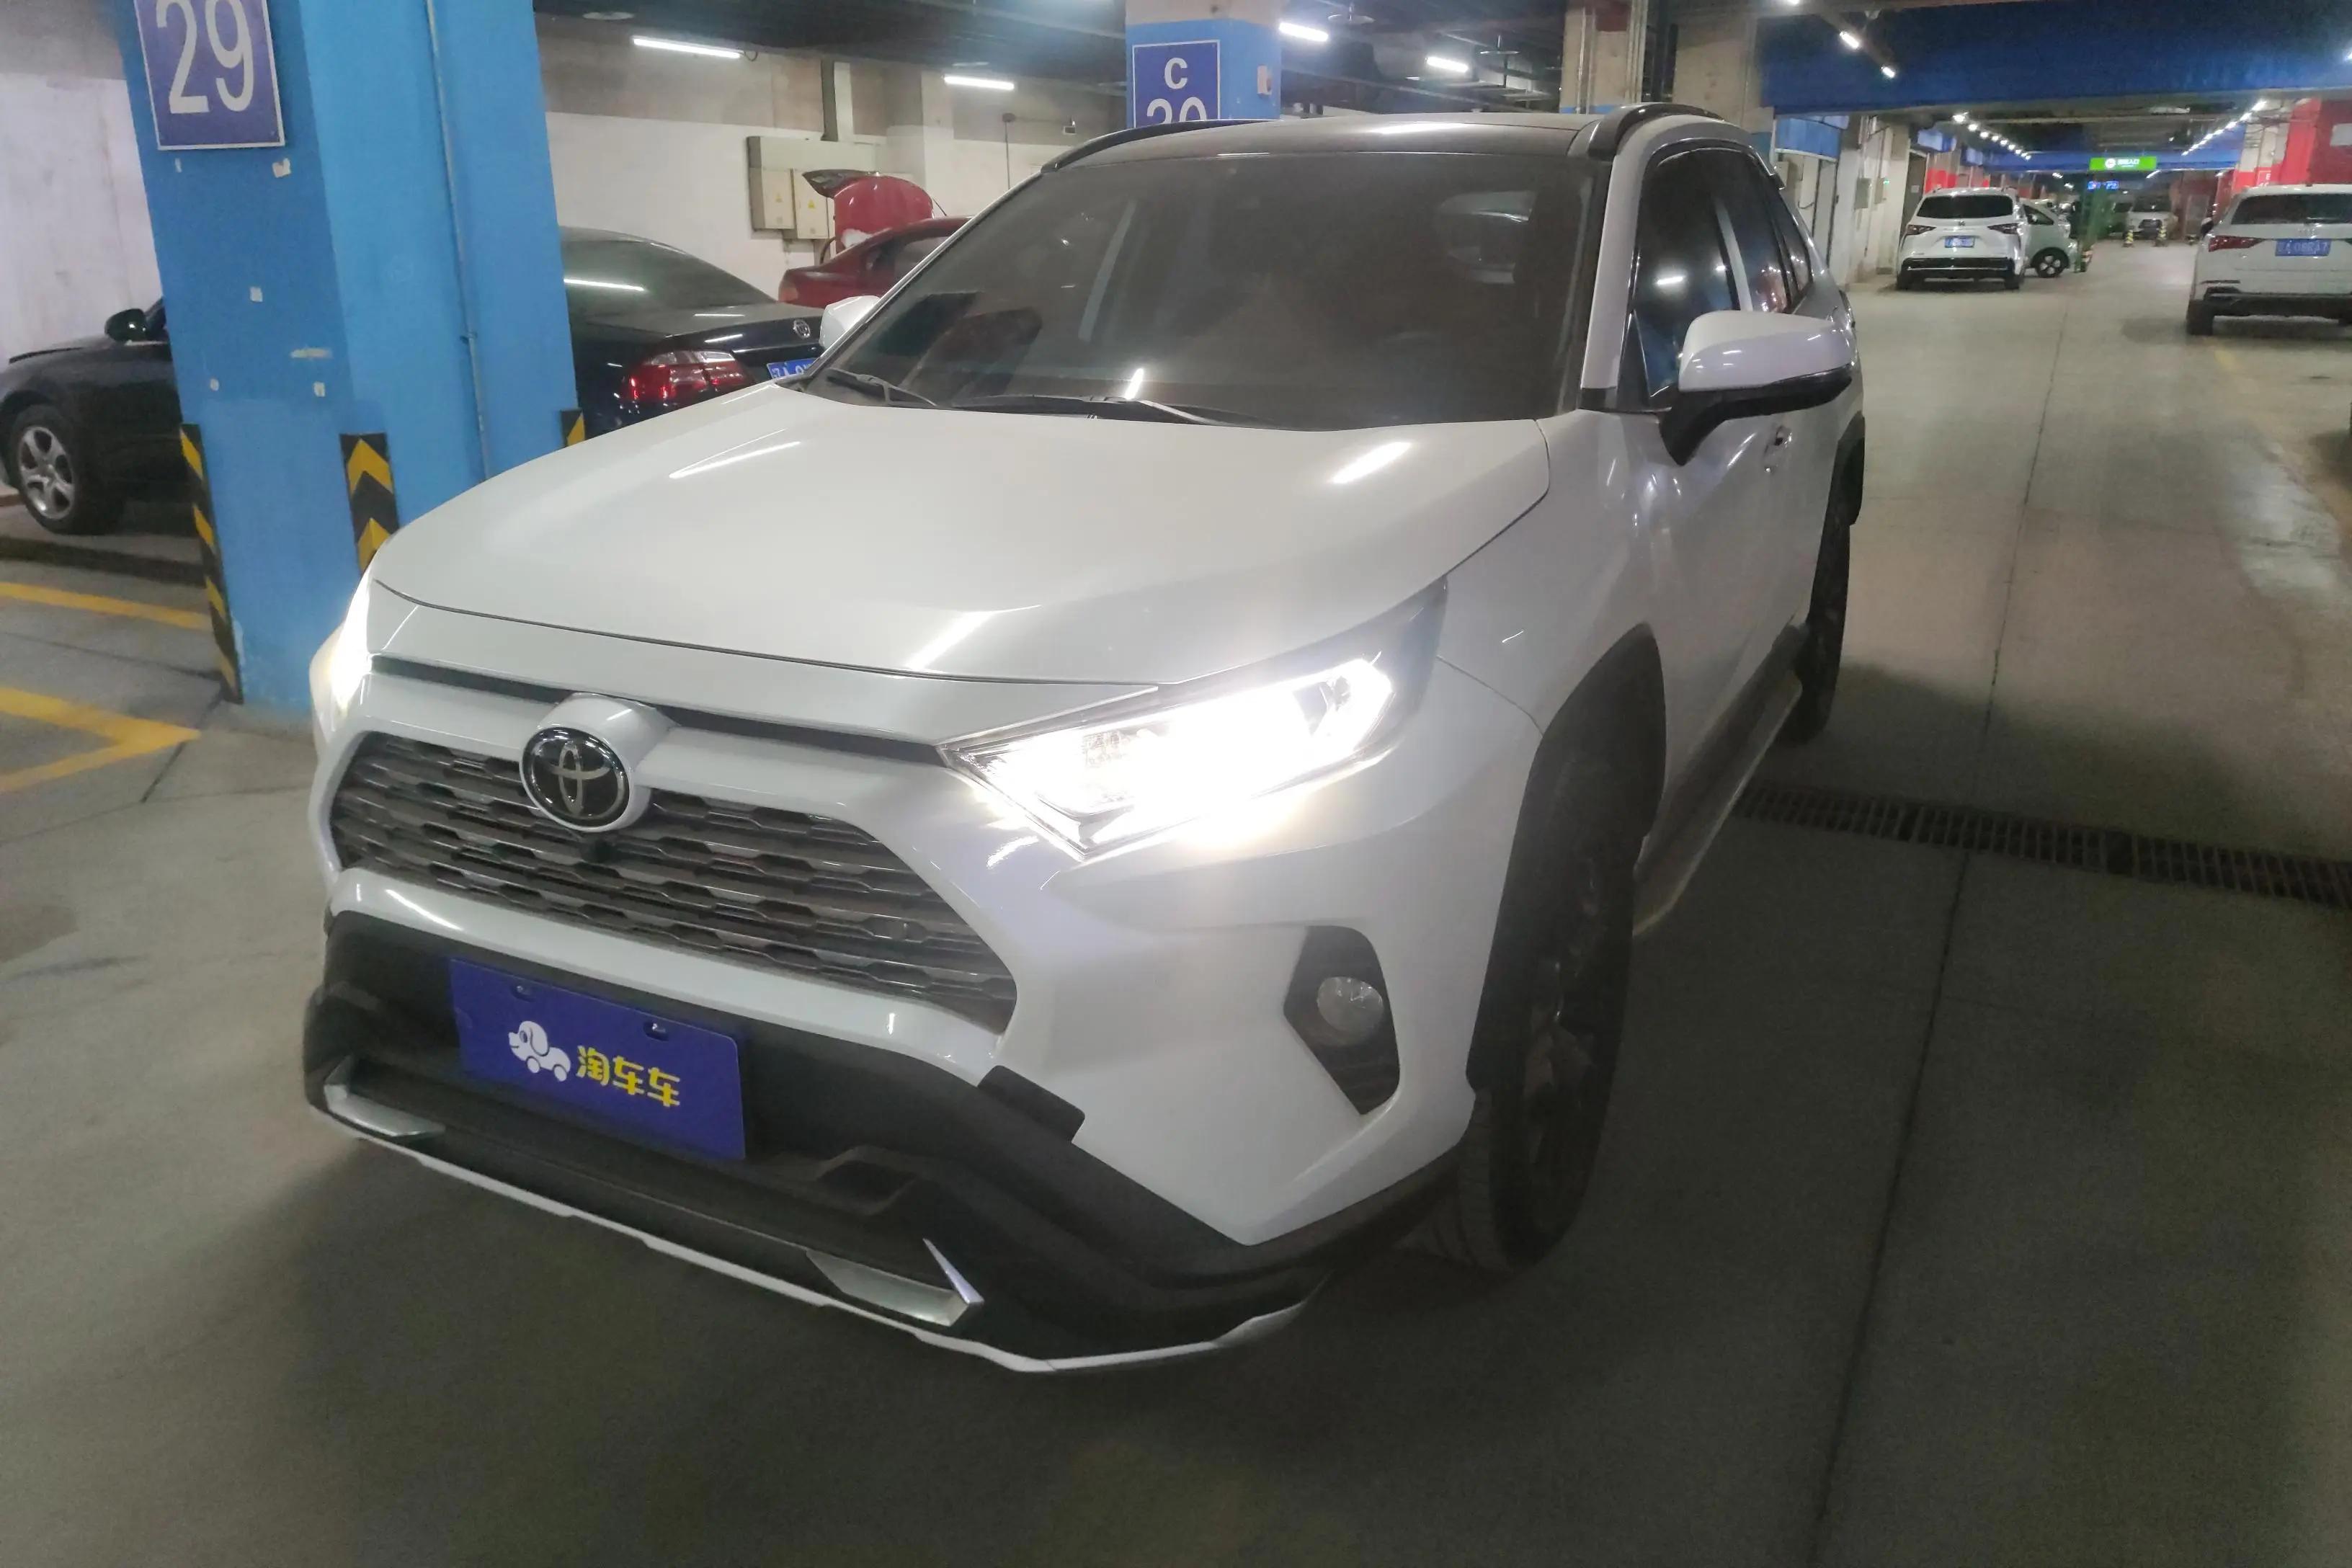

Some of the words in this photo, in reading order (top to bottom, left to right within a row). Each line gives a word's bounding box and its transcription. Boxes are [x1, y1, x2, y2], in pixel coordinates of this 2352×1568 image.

[156, 0, 254, 114] 29
[1164, 57, 1188, 90] C
[576, 1045, 681, 1108] 淘车车
